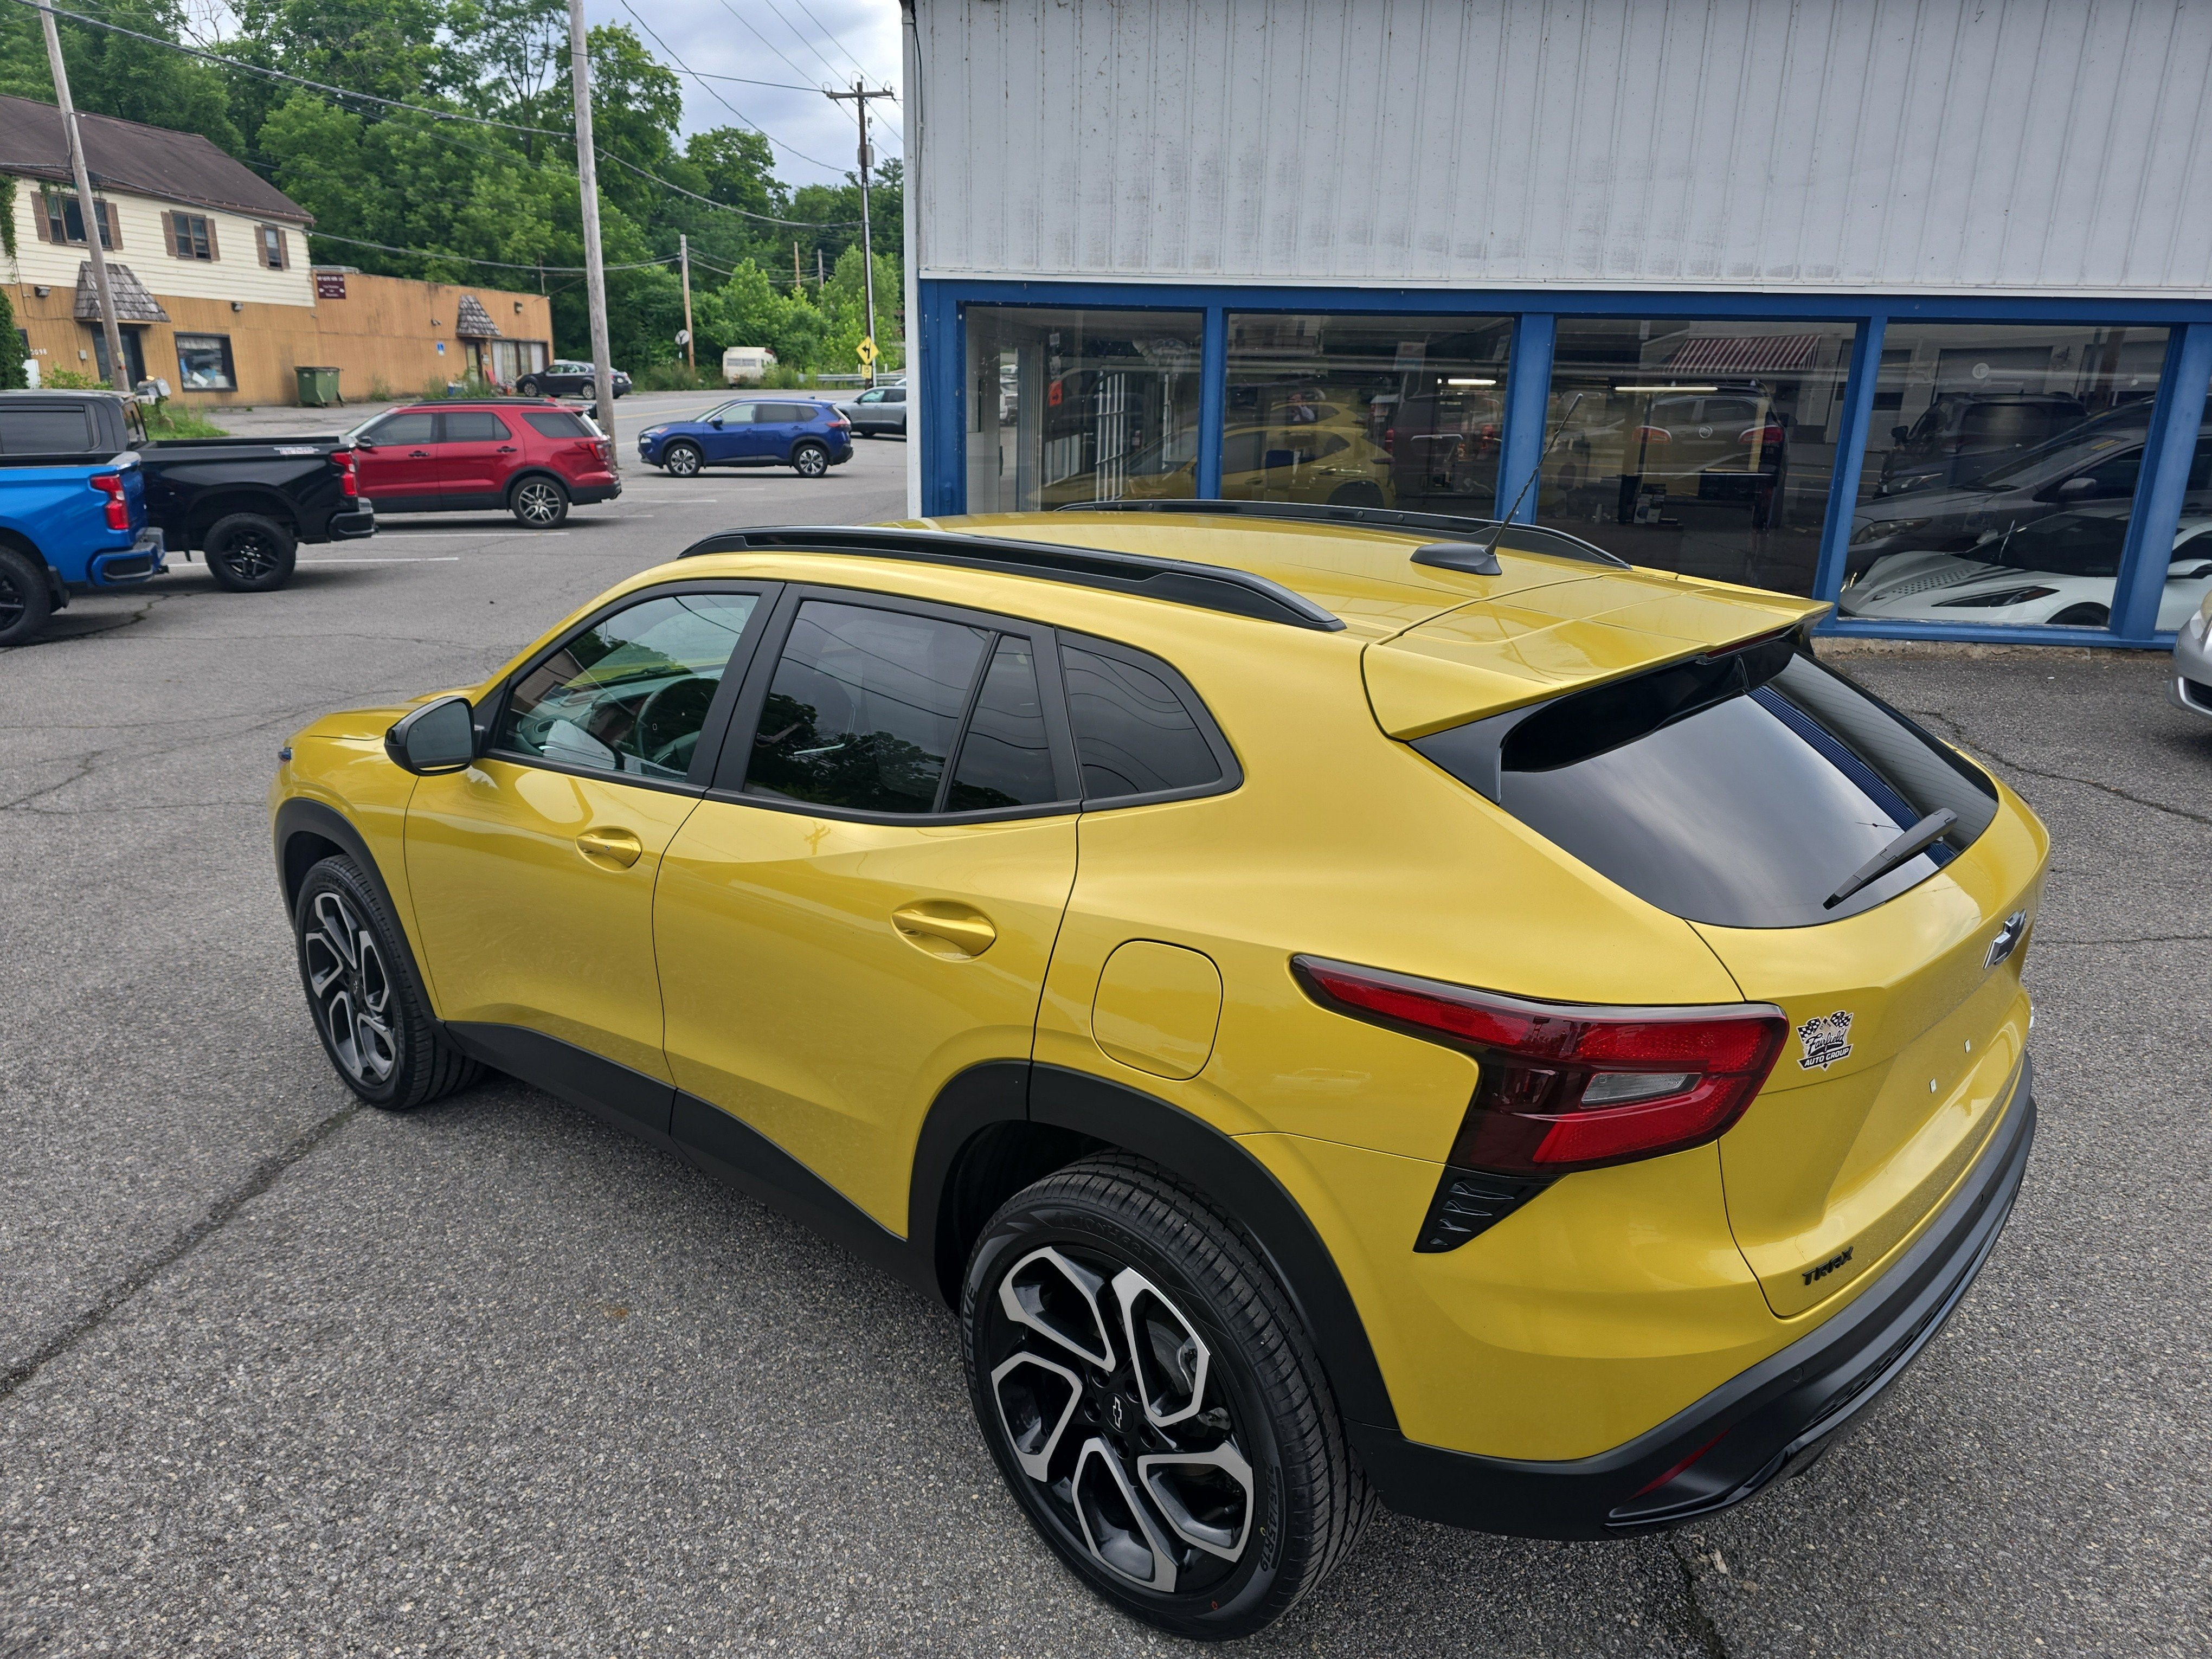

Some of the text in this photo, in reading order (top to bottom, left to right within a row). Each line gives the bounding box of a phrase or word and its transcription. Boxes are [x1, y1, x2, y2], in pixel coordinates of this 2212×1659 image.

[1805, 1028, 1847, 1056] Fairfield
[1804, 1047, 1849, 1066] AUTO GROUP
[1802, 1246, 1854, 1285] TRAX
